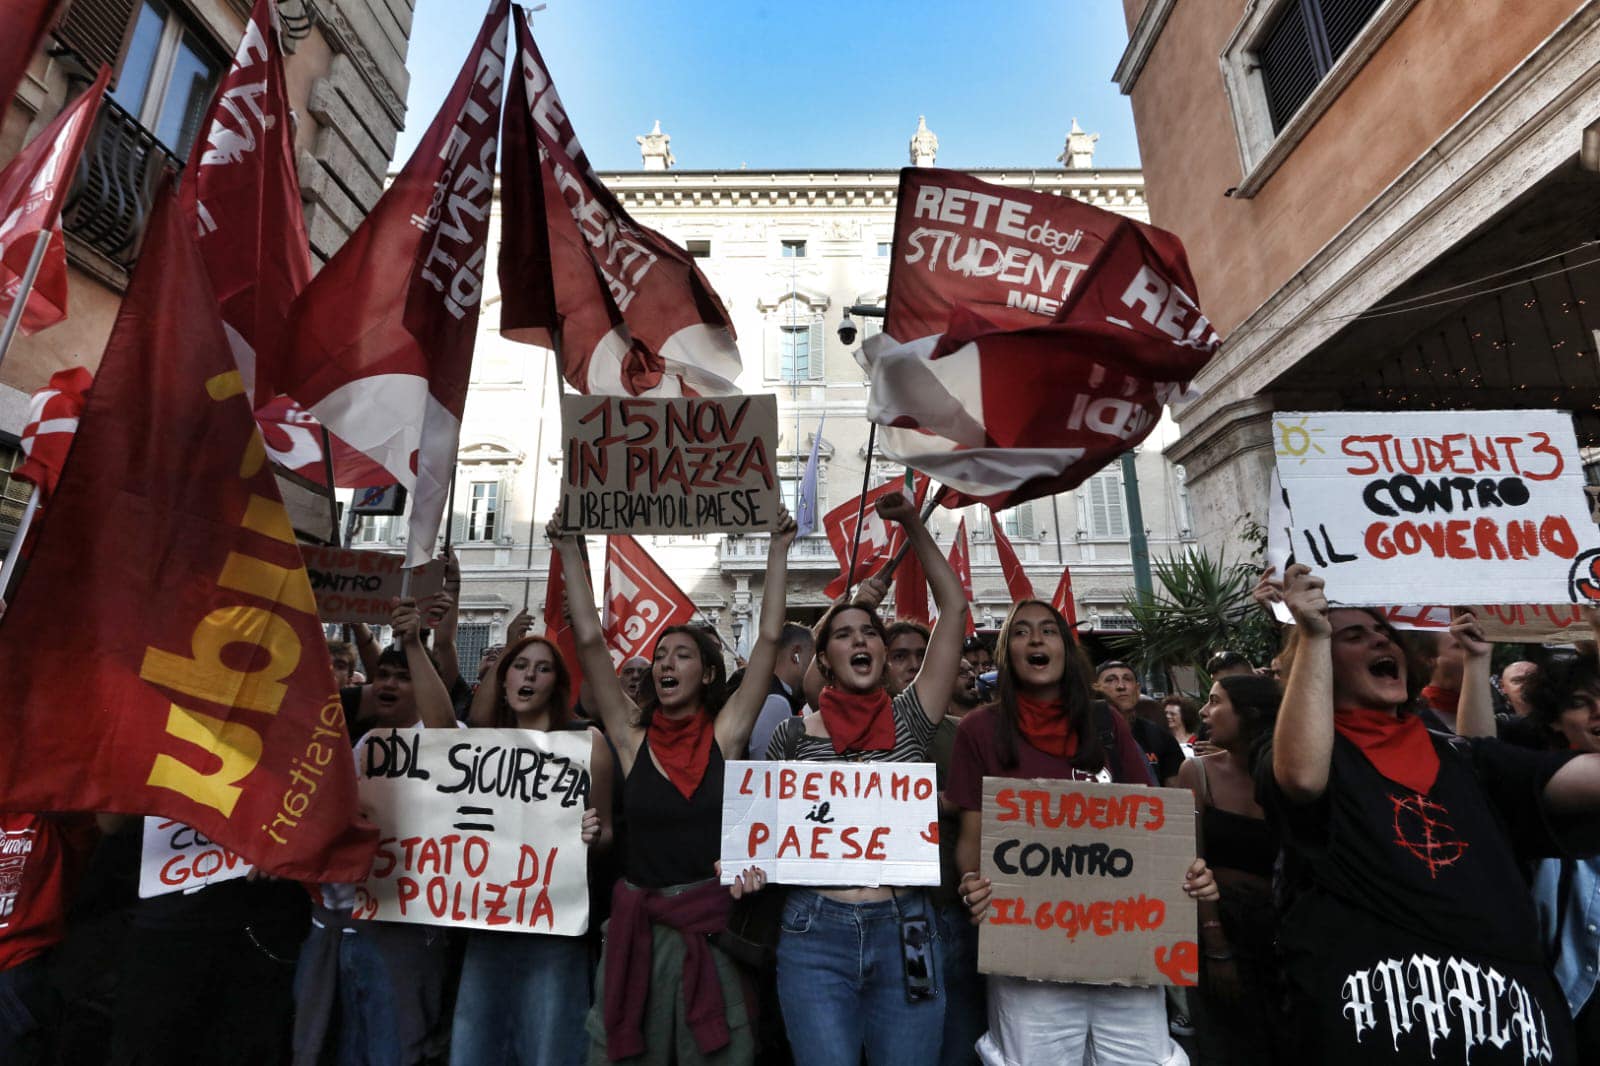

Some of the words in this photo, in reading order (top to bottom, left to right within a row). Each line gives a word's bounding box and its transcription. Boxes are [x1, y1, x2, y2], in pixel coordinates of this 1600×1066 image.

[914, 185, 1032, 239] RETE
[1026, 219, 1083, 255] degli
[905, 227, 1089, 301] STUDENT
[1007, 290, 1064, 317] ME
[579, 397, 659, 447] 15
[665, 397, 750, 448] NOV
[569, 436, 609, 490] IN
[626, 436, 774, 495] PIAZZA
[561, 490, 675, 532] LIBERIAMO
[679, 494, 693, 528] IL
[696, 489, 768, 527] PAESE
[1363, 474, 1530, 518] CONTRO
[1303, 523, 1359, 568] IL
[1364, 515, 1579, 561] GOVERNO
[308, 569, 382, 592] ONTRO
[366, 728, 430, 781] DDL
[740, 768, 933, 802] LIBERIAMO
[805, 802, 835, 824] il
[374, 834, 490, 879] STATO
[509, 844, 559, 889] DI
[748, 822, 891, 860] PAESE
[993, 839, 1134, 878] CONTRO
[159, 848, 252, 886] GOV
[397, 876, 555, 931] POLIZIA
[989, 896, 1032, 926] IL
[1034, 893, 1167, 939] GOVERNO
